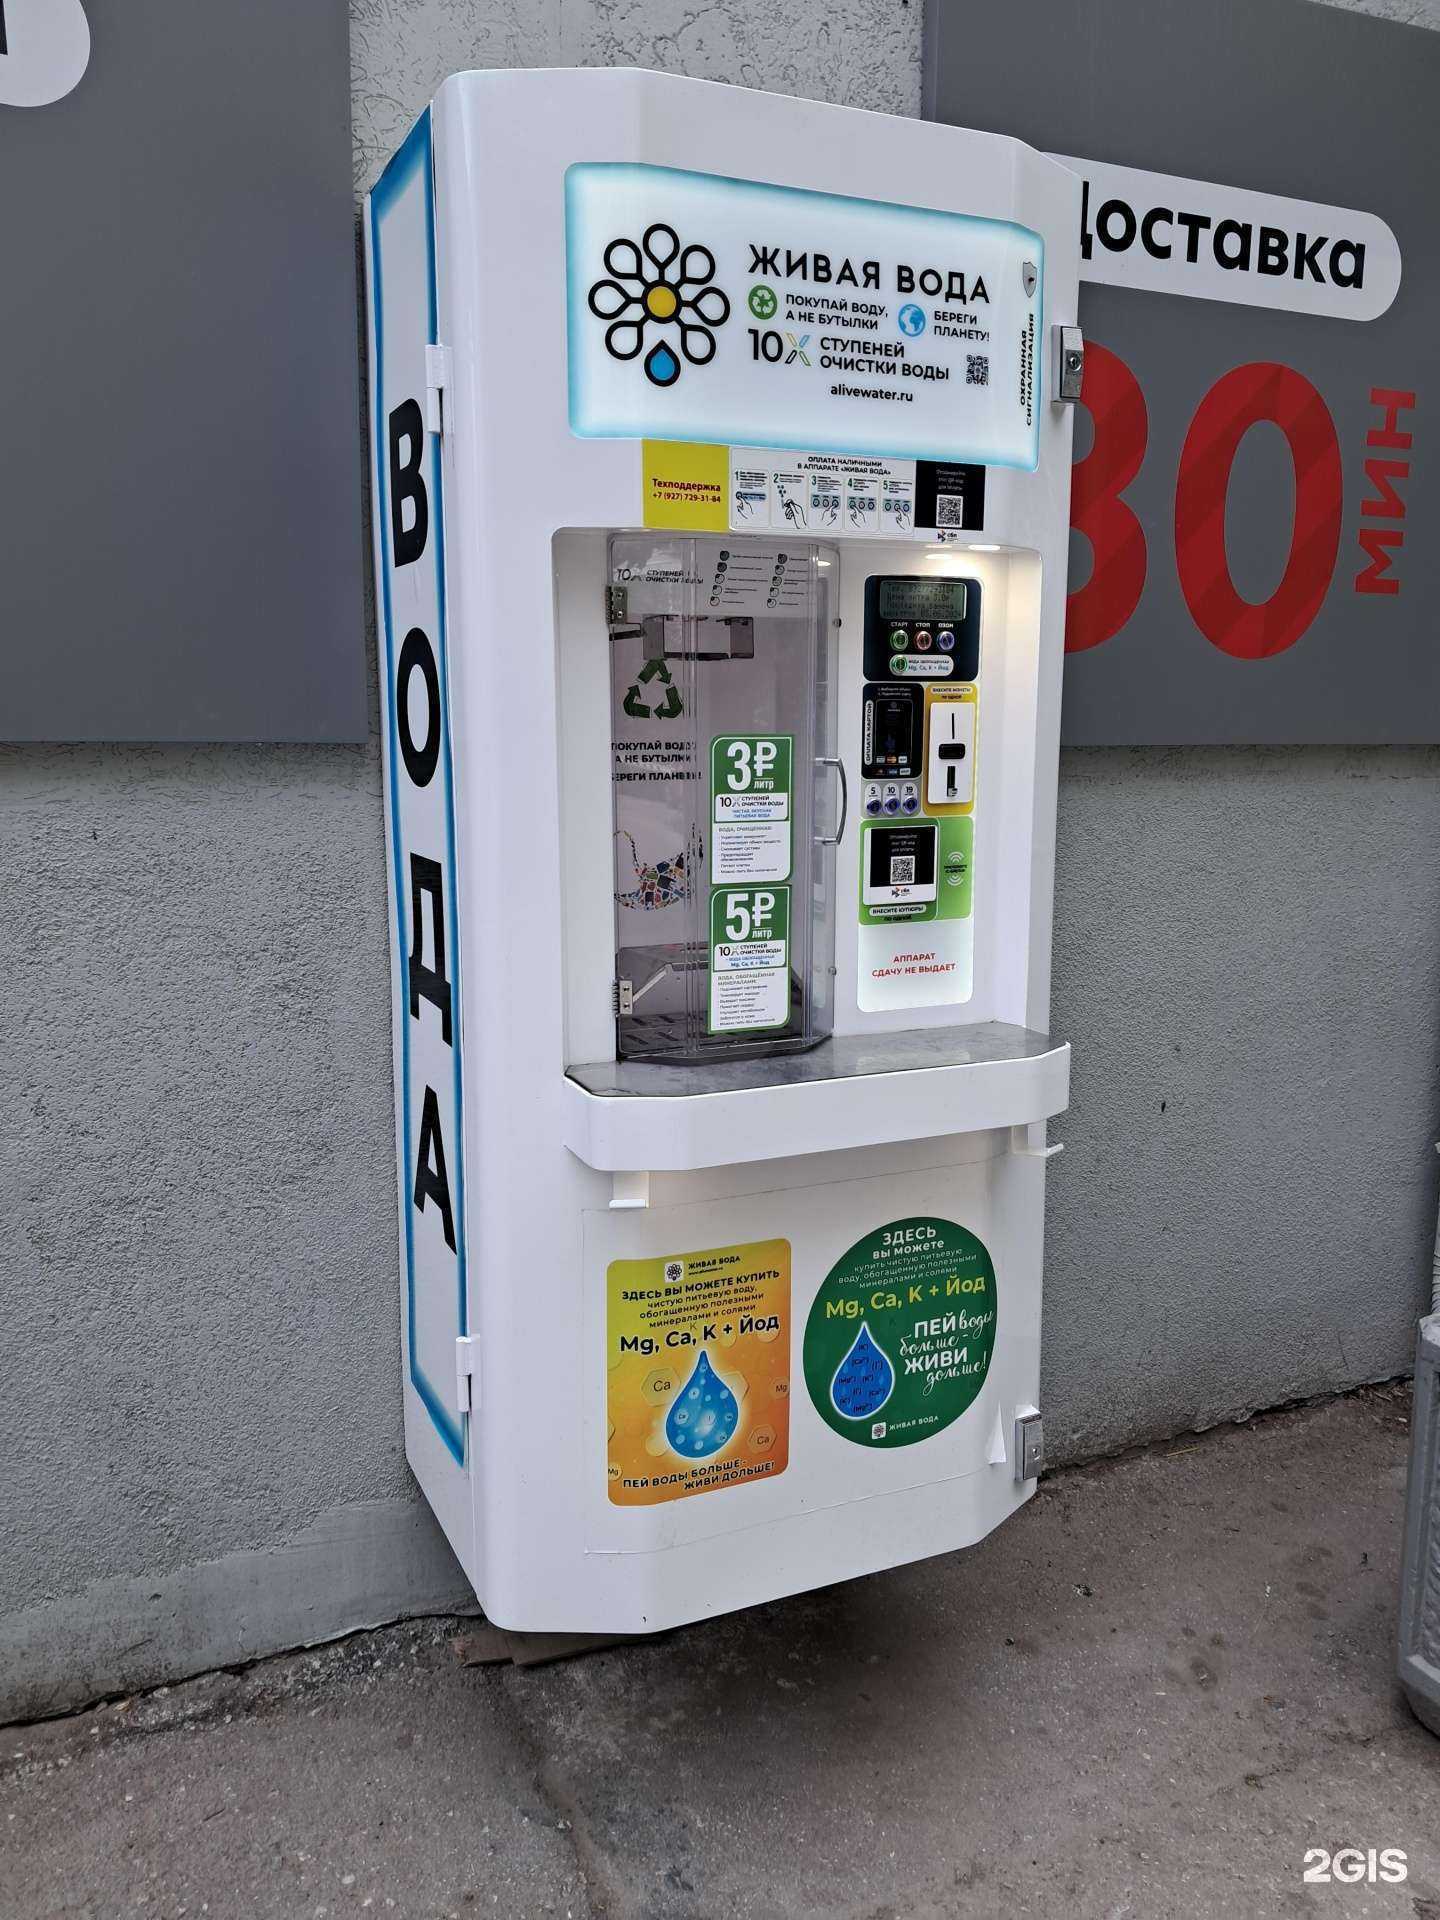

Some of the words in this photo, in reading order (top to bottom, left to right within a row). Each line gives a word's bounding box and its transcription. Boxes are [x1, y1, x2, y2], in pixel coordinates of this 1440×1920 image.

[748, 244, 880, 290] ЖИВАЯ
[897, 264, 990, 305] ВОДА
[786, 294, 848, 312] ПОКУПАЙ
[852, 302, 888, 318] ВОДУ,
[786, 310, 795, 320] А
[798, 312, 815, 323] НЕ
[818, 314, 878, 330] БУТЫЛКИ
[934, 310, 977, 325] БЕРЕГИ
[934, 326, 990, 342] ПЛАНЕТУ!
[820, 337, 904, 358] СТУПЕНЕЙ
[820, 355, 896, 375] ОЧИСТКИ
[902, 365, 949, 381] ВОДЫ
[1026, 313, 1035, 426] СИГНАЛИЗАЦИЯ
[830, 384, 913, 402] alivewater.ru
[803, 463, 839, 472] АППАРАТЕ
[807, 456, 836, 465] ОПЛАТА
[837, 458, 882, 467] НАЛИЧНЫМИ
[652, 478, 721, 492] Техподдержка
[625, 754, 639, 763] НЕ
[893, 953, 936, 963] АППАРАТ
[872, 968, 902, 978] СДАЧУ
[918, 963, 956, 973] ВЫДАЕТ
[882, 1226, 937, 1246] ЗДЕСЬ
[873, 1250, 891, 1260] вы
[894, 1239, 945, 1255] можете
[688, 1259, 717, 1270] ЖИВАЯ
[719, 1256, 741, 1265] ВОДА
[854, 1261, 886, 1273] купить
[887, 1256, 919, 1267] чистую
[920, 1248, 963, 1261] питьевую
[927, 1253, 977, 1268] полезными
[622, 1289, 661, 1301] ЗДЕСЬ
[665, 1286, 682, 1296] ВЫ
[685, 1277, 733, 1293] МОЖЕТЕ
[736, 1270, 780, 1284] КУПИТЬ
[859, 1274, 916, 1289] минералами
[925, 1266, 957, 1277] солями
[639, 1302, 709, 1319] обогащенную
[711, 1293, 764, 1307] полезными
[648, 1297, 683, 1309] чистую
[685, 1290, 732, 1304] питьевую
[826, 1299, 864, 1319] Mg,
[871, 1291, 902, 1310] Ca,
[929, 1285, 939, 1297] +
[946, 1275, 986, 1297] Йод
[649, 1312, 711, 1328] минералами
[722, 1305, 756, 1316] солями
[914, 1311, 956, 1339] ПЕЙ
[958, 1308, 994, 1339] воды
[620, 1335, 659, 1355] Mg,
[666, 1330, 697, 1347] Ca,
[723, 1324, 733, 1335] +
[740, 1314, 780, 1334] Йод
[900, 1334, 959, 1357] больше
[904, 1347, 968, 1375] ЖИВИ
[653, 1379, 671, 1392] Ca
[889, 1422, 917, 1431] ЖИВАЯ
[919, 1415, 939, 1425] ВОДА
[623, 1478, 649, 1488] ПЕЙ
[652, 1472, 688, 1487] ВОДЫ
[691, 1459, 740, 1478] БОЛЬШЕ
[684, 1475, 720, 1490] ЖИВИ
[722, 1461, 775, 1483] ДОЛЬШЕ!
